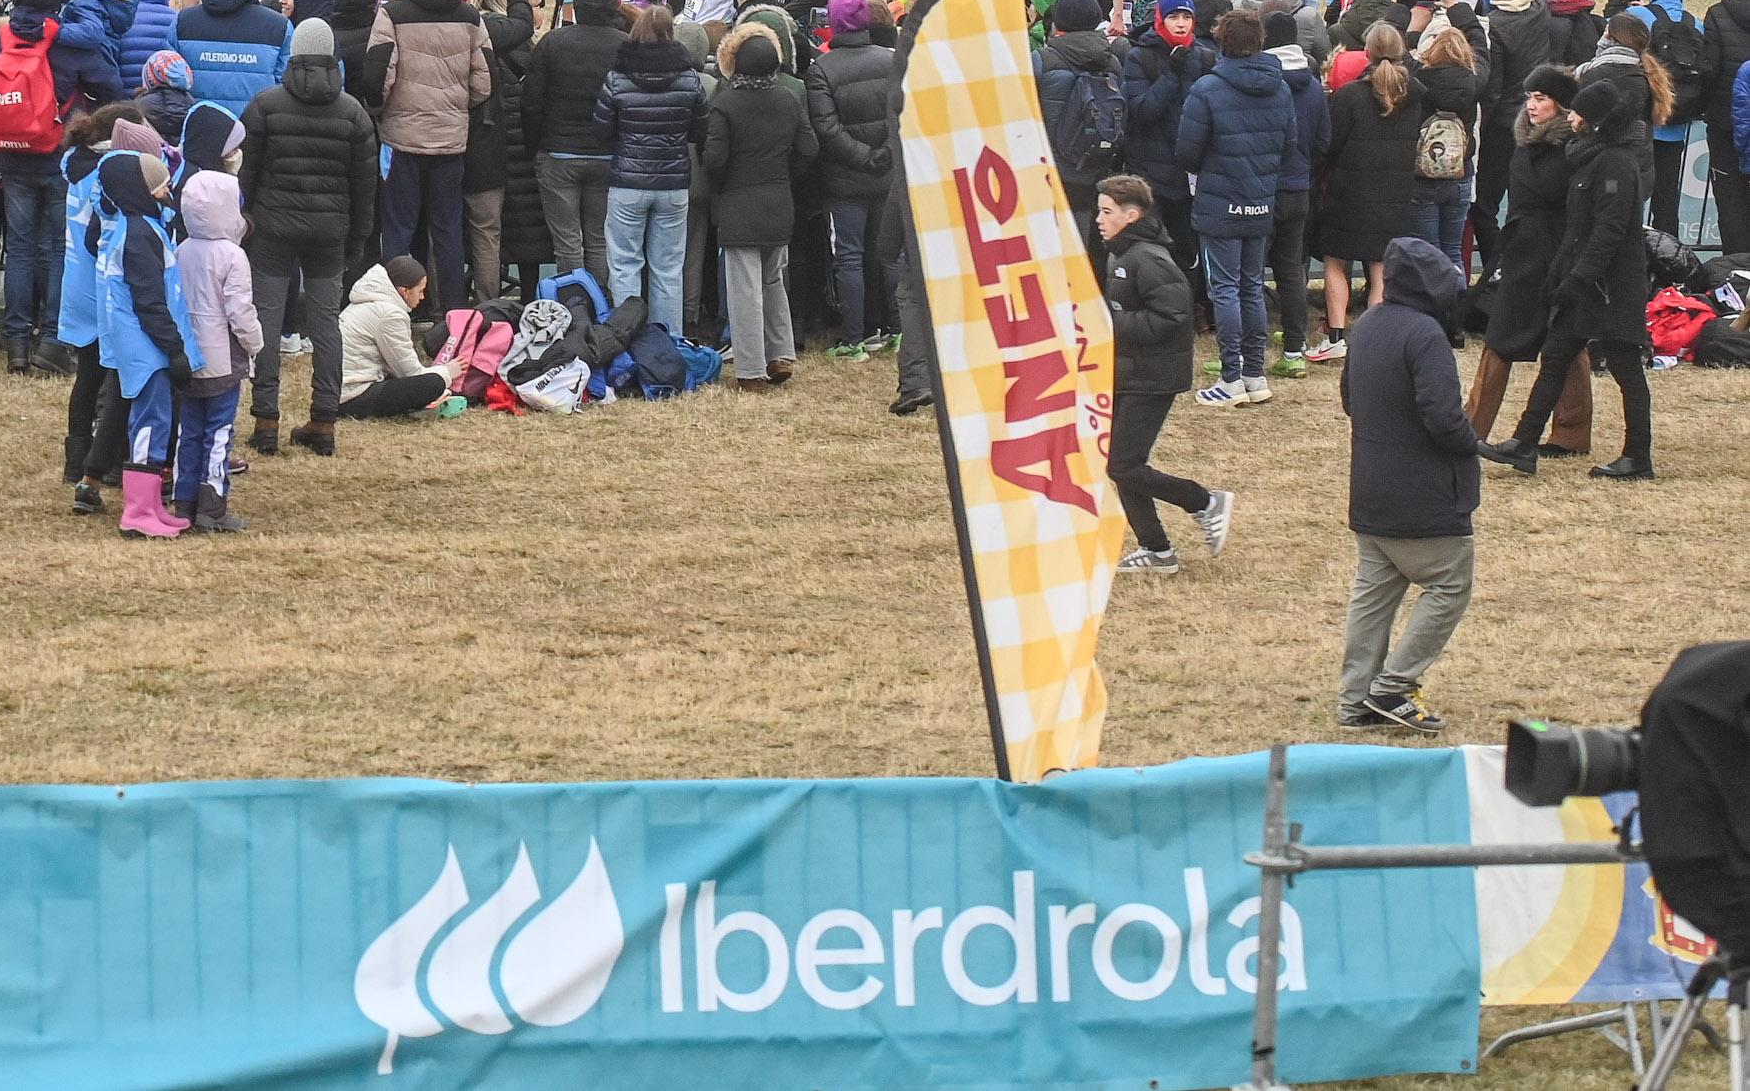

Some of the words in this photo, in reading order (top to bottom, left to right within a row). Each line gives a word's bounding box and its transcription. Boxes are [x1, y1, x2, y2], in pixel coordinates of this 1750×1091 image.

[200, 51, 238, 64] ATLETISMO
[238, 54, 258, 65] SADA
[1228, 203, 1243, 215] LA
[1244, 204, 1269, 216] RIOJA
[953, 144, 1099, 518] ANETO
[661, 867, 1309, 1014] Iberdrola
